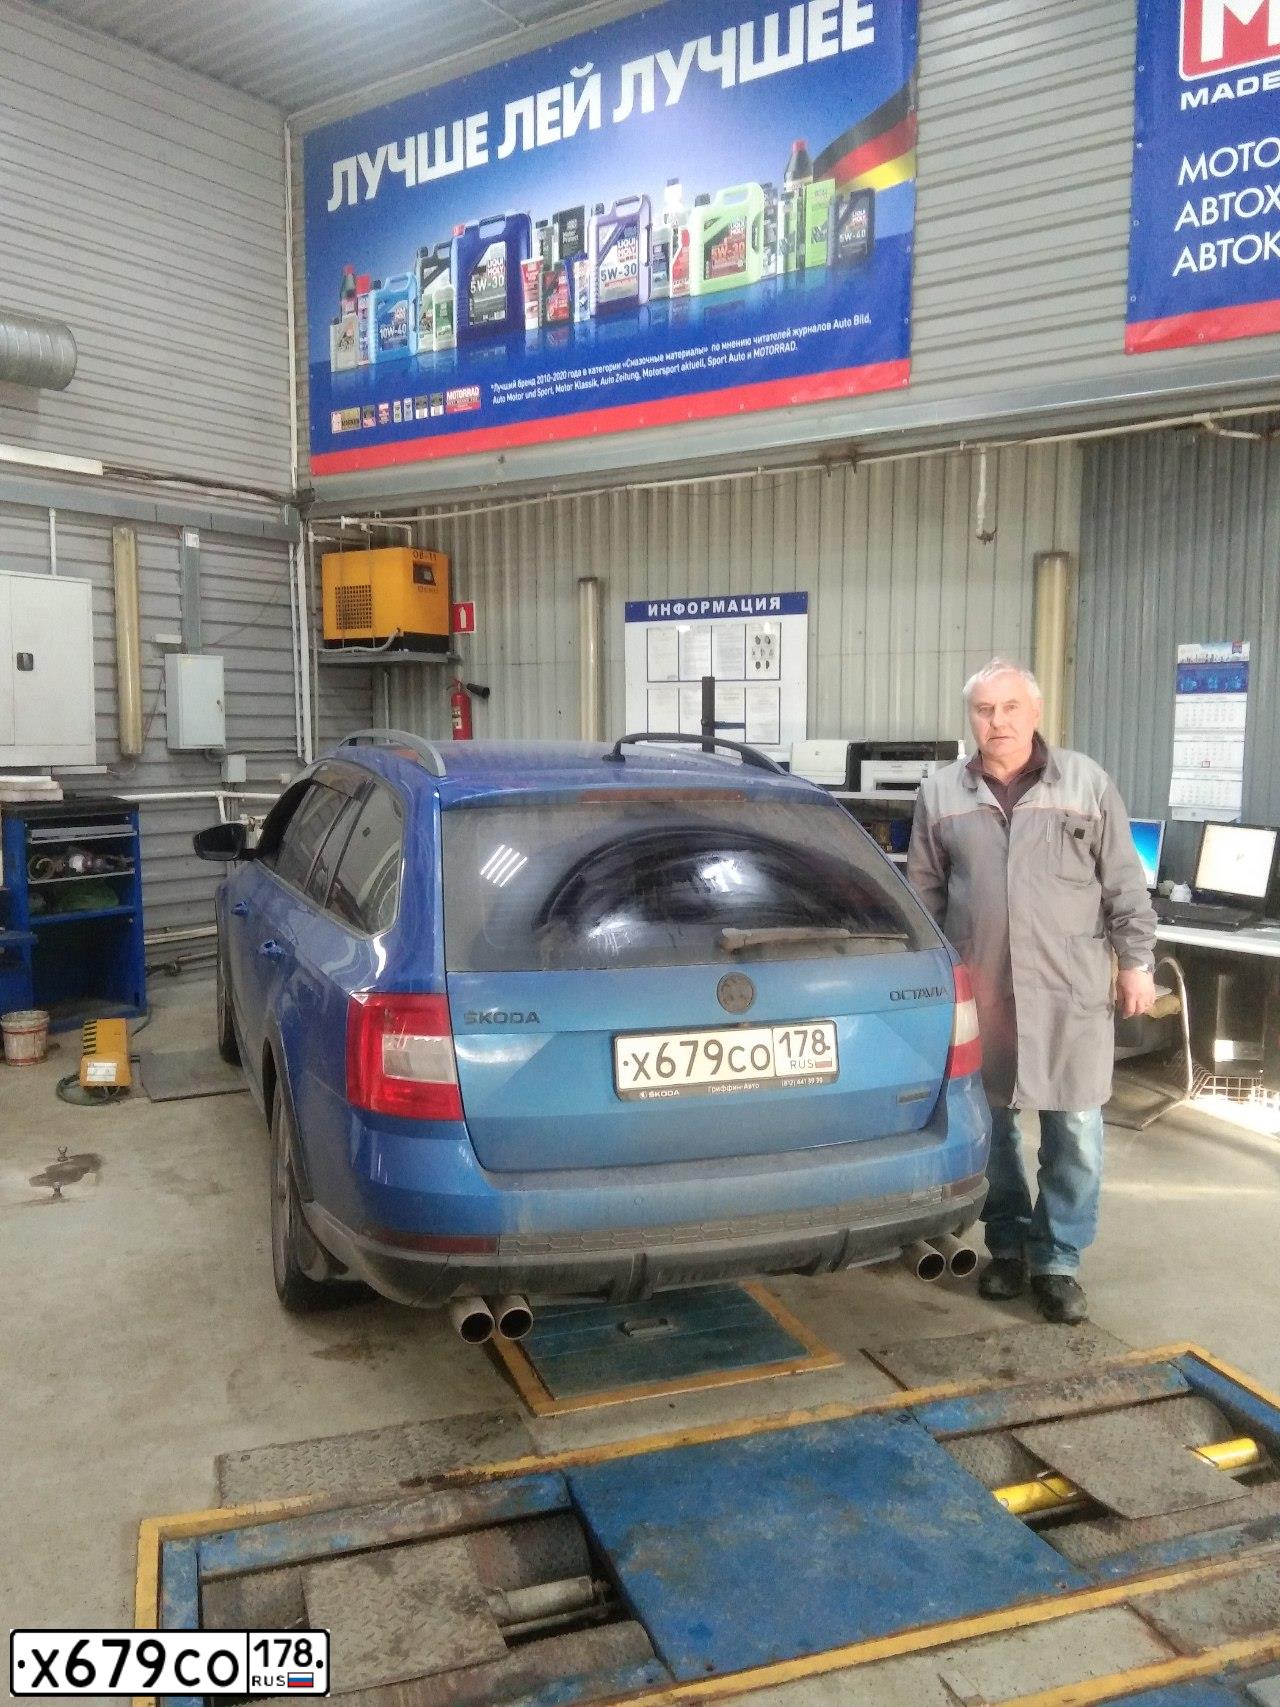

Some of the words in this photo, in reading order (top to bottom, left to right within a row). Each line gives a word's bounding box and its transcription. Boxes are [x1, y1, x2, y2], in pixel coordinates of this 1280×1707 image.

[1180, 69, 1280, 111] MADE
[327, 111, 489, 212] ЛУЧШЕ
[498, 63, 602, 159] ЛЕЙ
[612, 0, 875, 124] ЛУЧШЕЕ
[470, 274, 505, 294] 5W-30
[601, 262, 637, 282] 5W-30
[517, 378, 536, 389] бренд
[537, 370, 567, 385] 2010-2020
[567, 369, 582, 380] года
[588, 362, 621, 377] категории
[711, 342, 721, 353] по
[721, 336, 752, 350] мнению
[753, 326, 792, 344] читателей
[792, 321, 832, 338] журналов
[833, 318, 852, 330] Auto
[853, 312, 872, 326] Bild,
[492, 395, 506, 405] Auto
[506, 392, 524, 402] Motor
[525, 389, 537, 400] und
[555, 382, 573, 394] Motor
[574, 377, 599, 391] Klassik,
[600, 375, 615, 386] Auto
[642, 363, 681, 378] Motorsport
[707, 353, 728, 367] Sport
[728, 351, 746, 363] Auto
[648, 596, 781, 617] ИНФОРМАЦИЯ
[778, 1029, 826, 1059] 178
[790, 1058, 814, 1069] RUS
